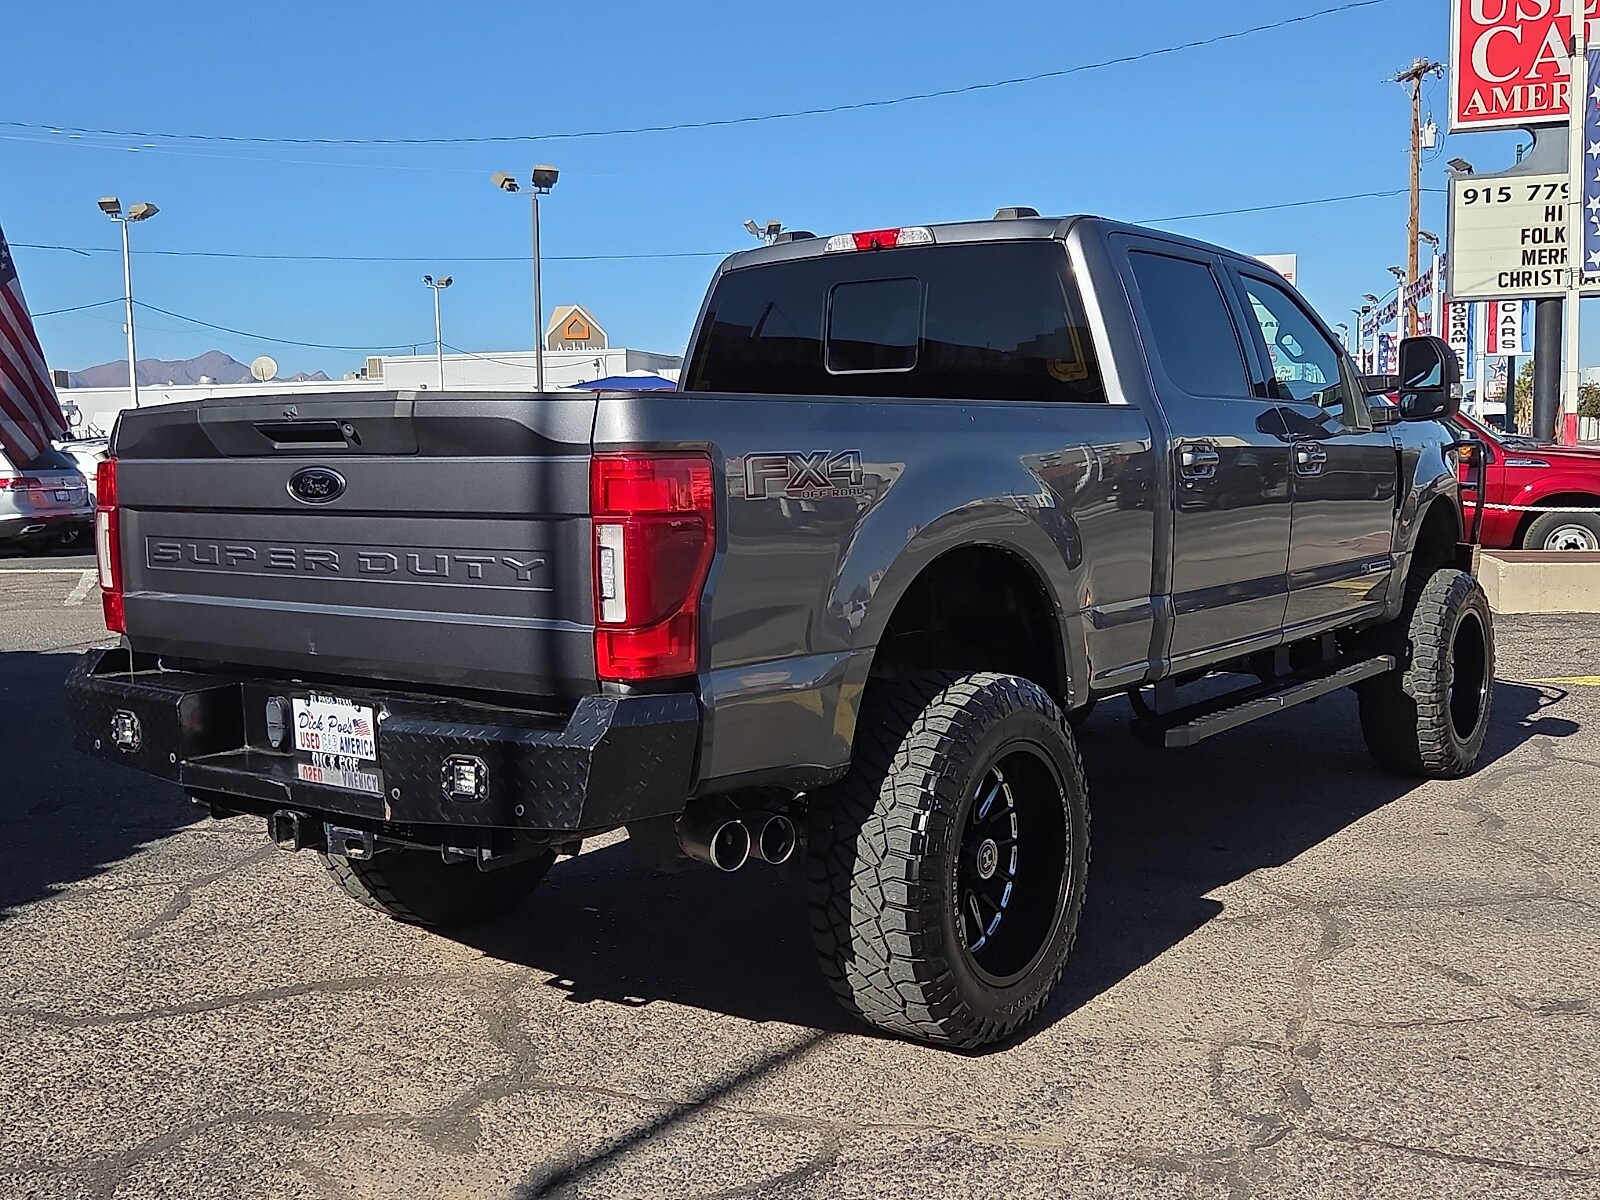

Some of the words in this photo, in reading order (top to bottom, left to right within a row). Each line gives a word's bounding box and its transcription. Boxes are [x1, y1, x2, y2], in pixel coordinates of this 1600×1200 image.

[1471, 20, 1600, 83] CA
[1463, 186, 1512, 205] 915
[1544, 205, 1563, 222] HI
[1521, 226, 1566, 245] FOLK
[1500, 303, 1517, 349] CARS
[299, 474, 331, 495] Ford
[743, 449, 865, 500] FX4
[801, 489, 828, 499] OFF
[832, 487, 865, 498] ROAD
[152, 541, 341, 573] SUPER
[357, 550, 547, 582] DUTY
[298, 711, 324, 730] Dick
[327, 715, 353, 734] Poe's
[300, 731, 320, 750] USED
[339, 736, 375, 758] AMERICA
[311, 751, 336, 770] DICK
[339, 755, 360, 773] POE
